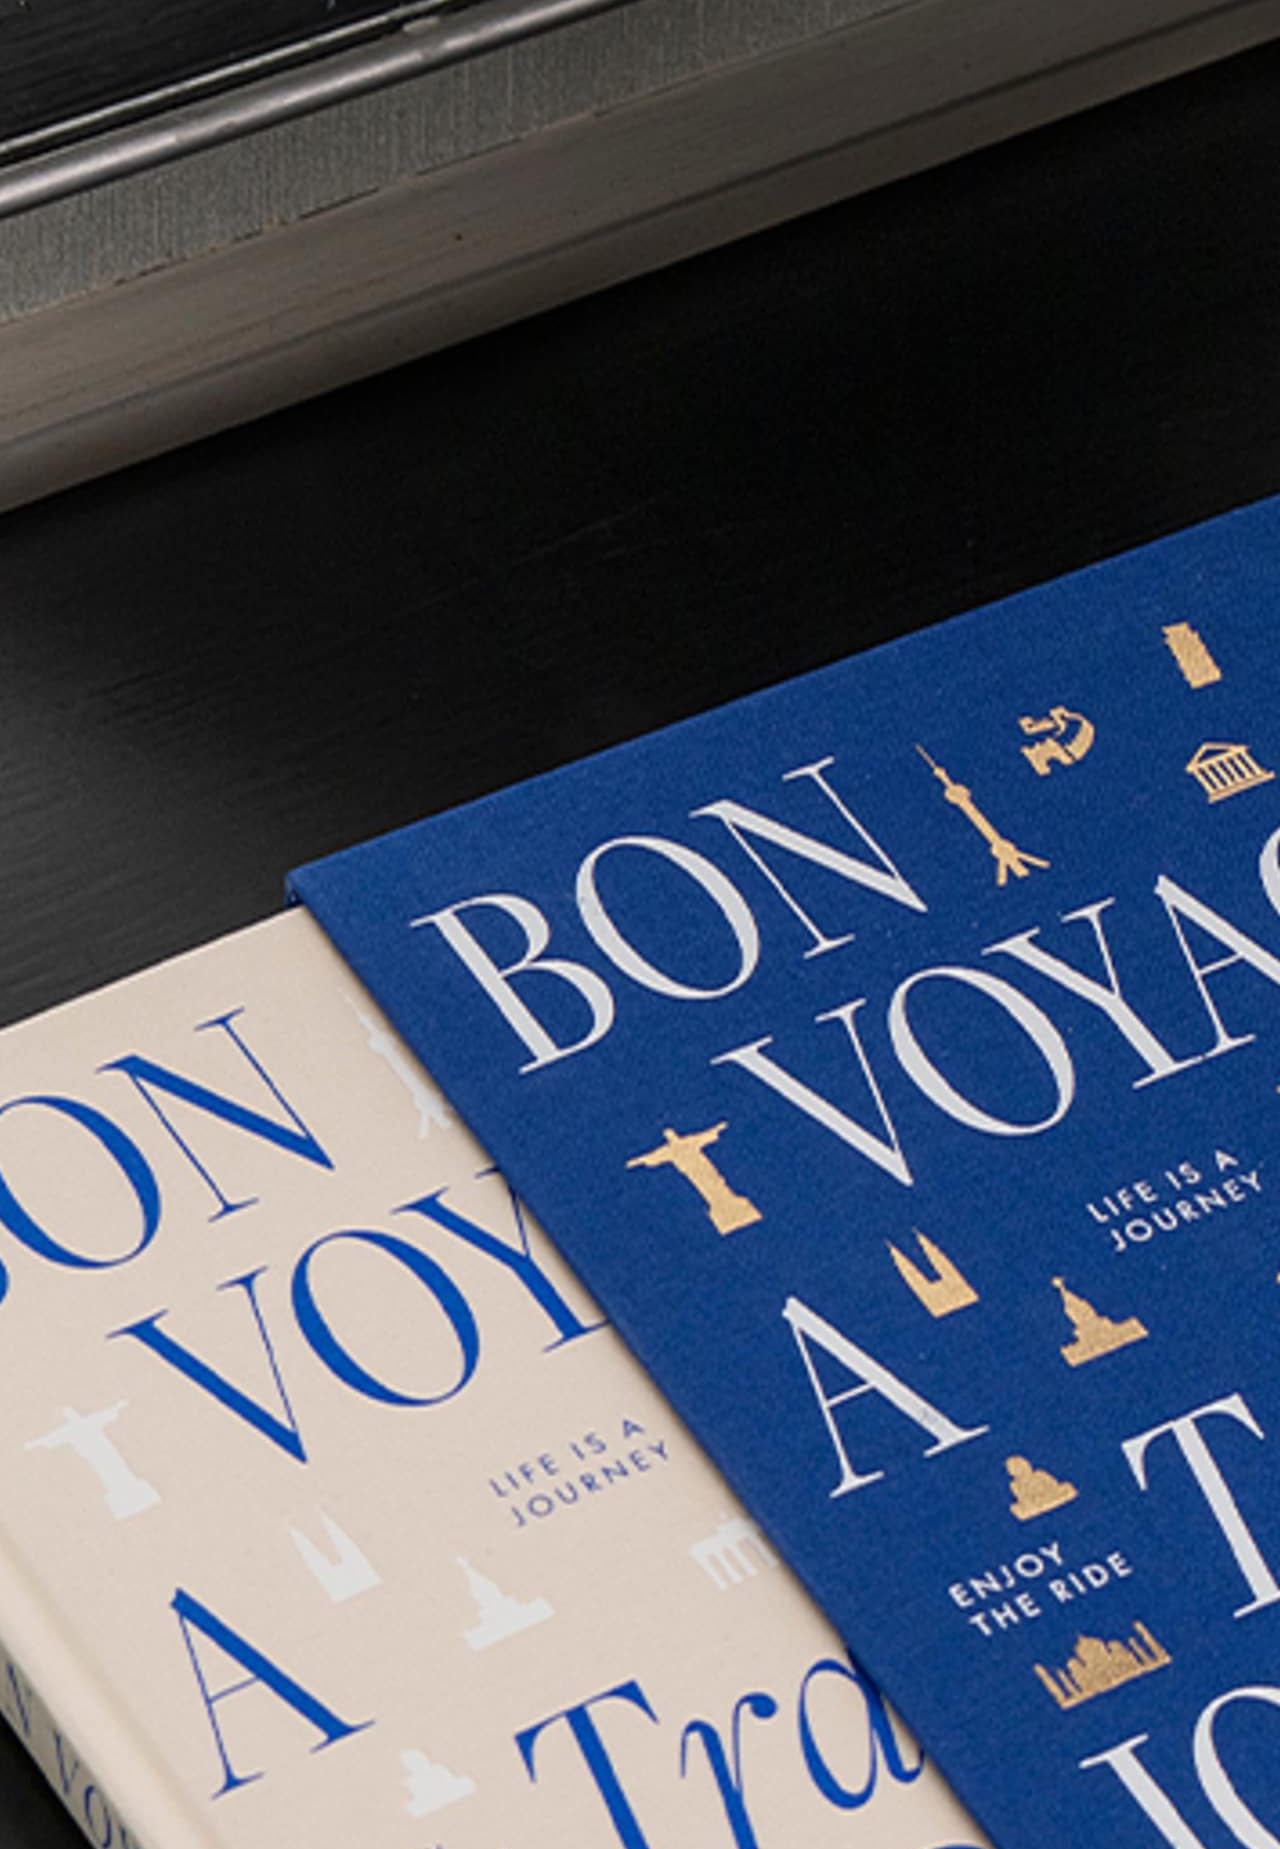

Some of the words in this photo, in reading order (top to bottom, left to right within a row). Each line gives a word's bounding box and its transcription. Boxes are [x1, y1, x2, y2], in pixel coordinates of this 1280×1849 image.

[413, 757, 927, 1075] BON
[1086, 1178, 1158, 1224] LIFE
[1165, 1162, 1202, 1191] IS
[1215, 1149, 1239, 1171] A
[1110, 1170, 1263, 1252] JOURNEY
[783, 1296, 988, 1497] A
[487, 1452, 561, 1499] LIFE
[567, 1432, 608, 1463] IS
[621, 1417, 646, 1442] A
[509, 1439, 670, 1528] JOURNEY
[947, 1541, 1066, 1610] ENJOY
[967, 1592, 1041, 1638] THE
[1050, 1551, 1133, 1605] RIDE
[171, 1588, 376, 1800] A
